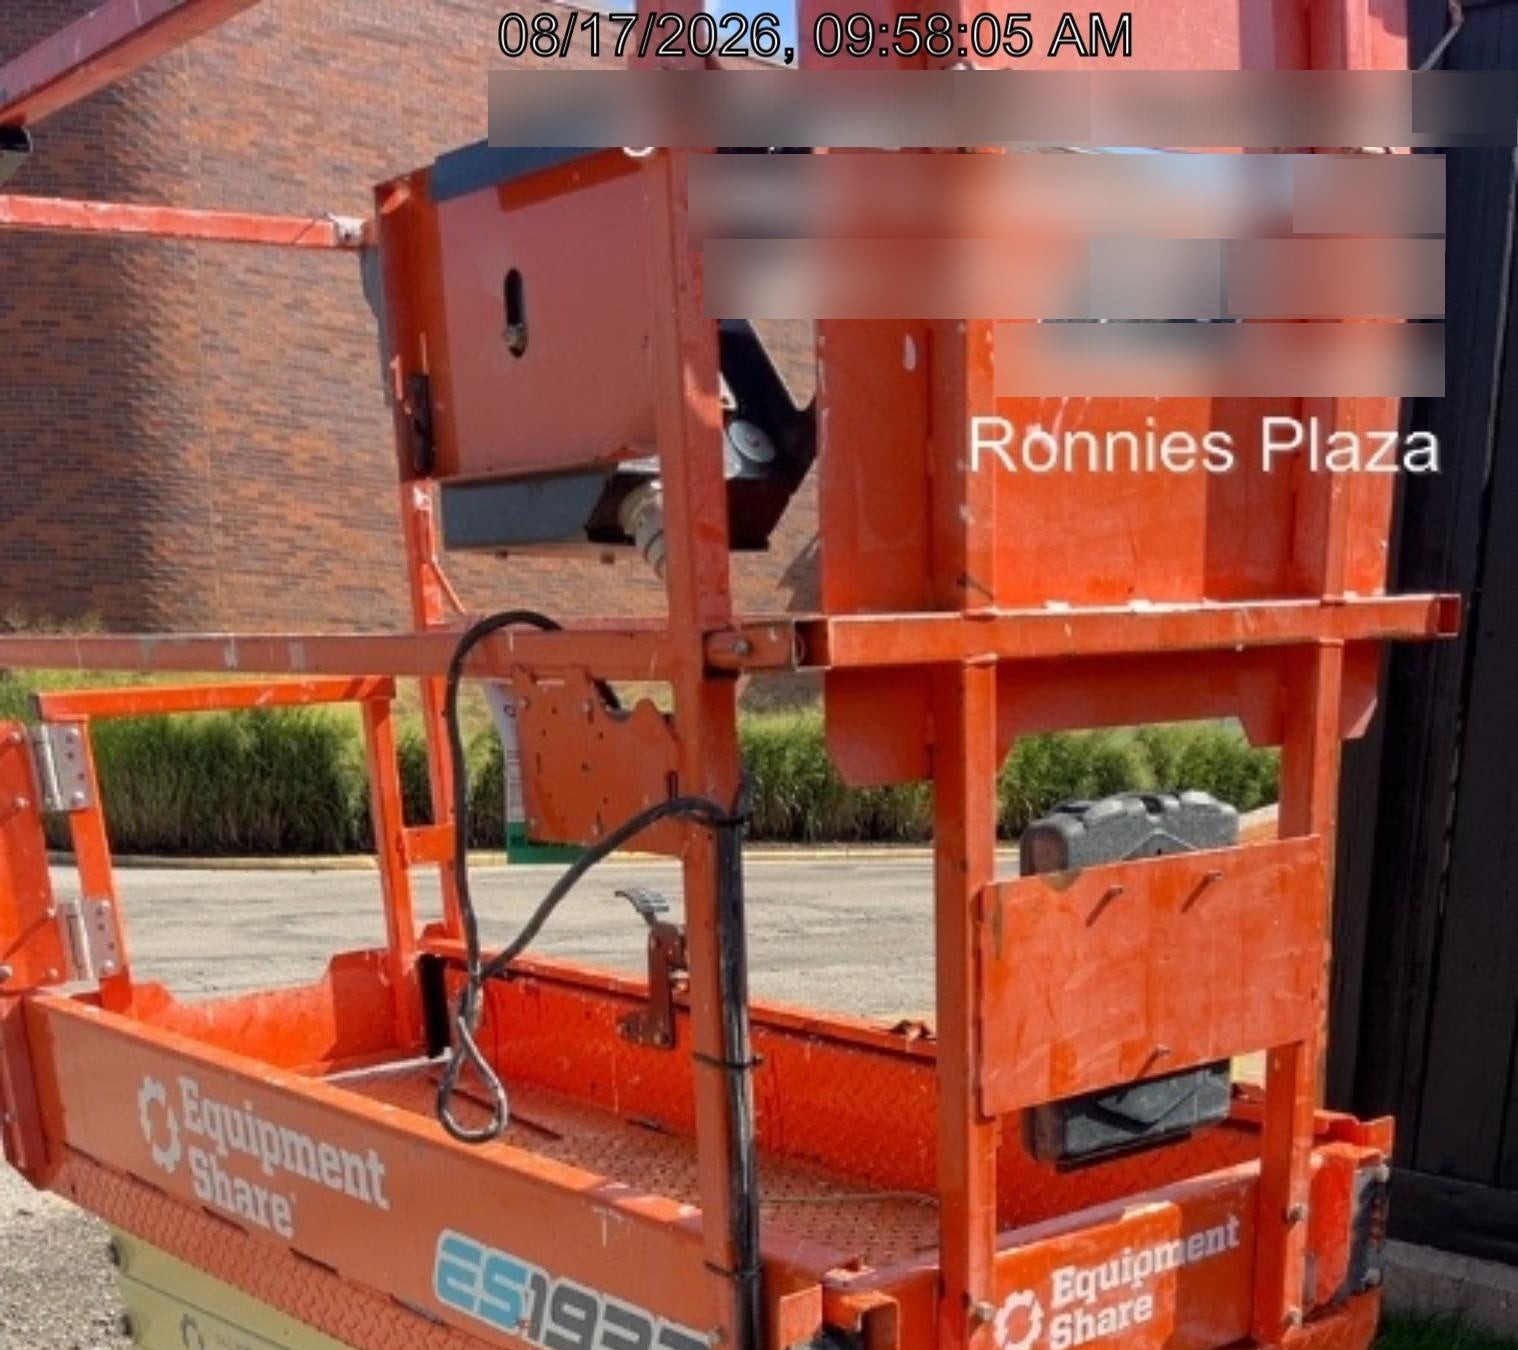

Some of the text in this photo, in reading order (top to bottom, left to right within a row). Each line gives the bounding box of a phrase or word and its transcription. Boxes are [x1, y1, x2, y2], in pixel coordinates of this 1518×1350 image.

[178, 1076, 390, 1210] Equipment
[188, 1146, 294, 1239] Share
[1052, 1213, 1241, 1308] Equipment
